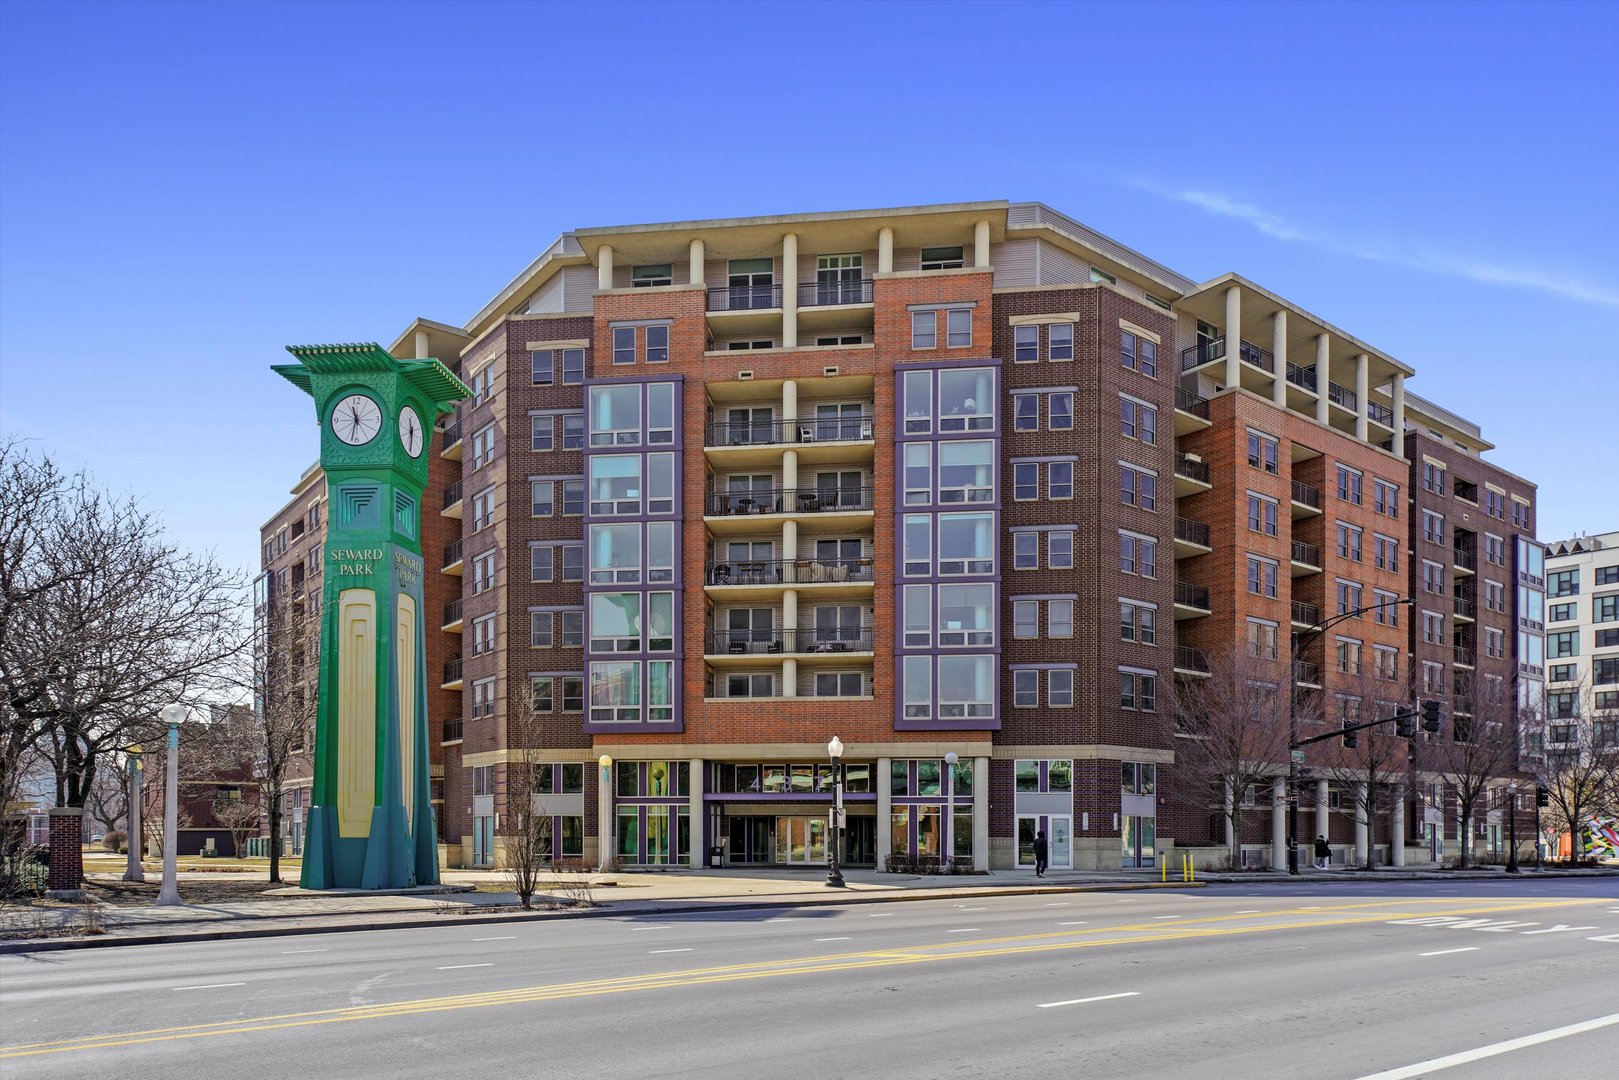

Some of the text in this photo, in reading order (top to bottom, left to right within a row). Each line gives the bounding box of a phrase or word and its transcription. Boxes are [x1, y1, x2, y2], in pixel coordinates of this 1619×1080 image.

[352, 397, 361, 405] 12
[375, 415, 380, 424] 3
[331, 548, 383, 560] SEWARD
[395, 551, 421, 572] SEWARD
[340, 564, 373, 575] PARK
[399, 568, 417, 585] PARK
[1385, 916, 1601, 935] ONLY
